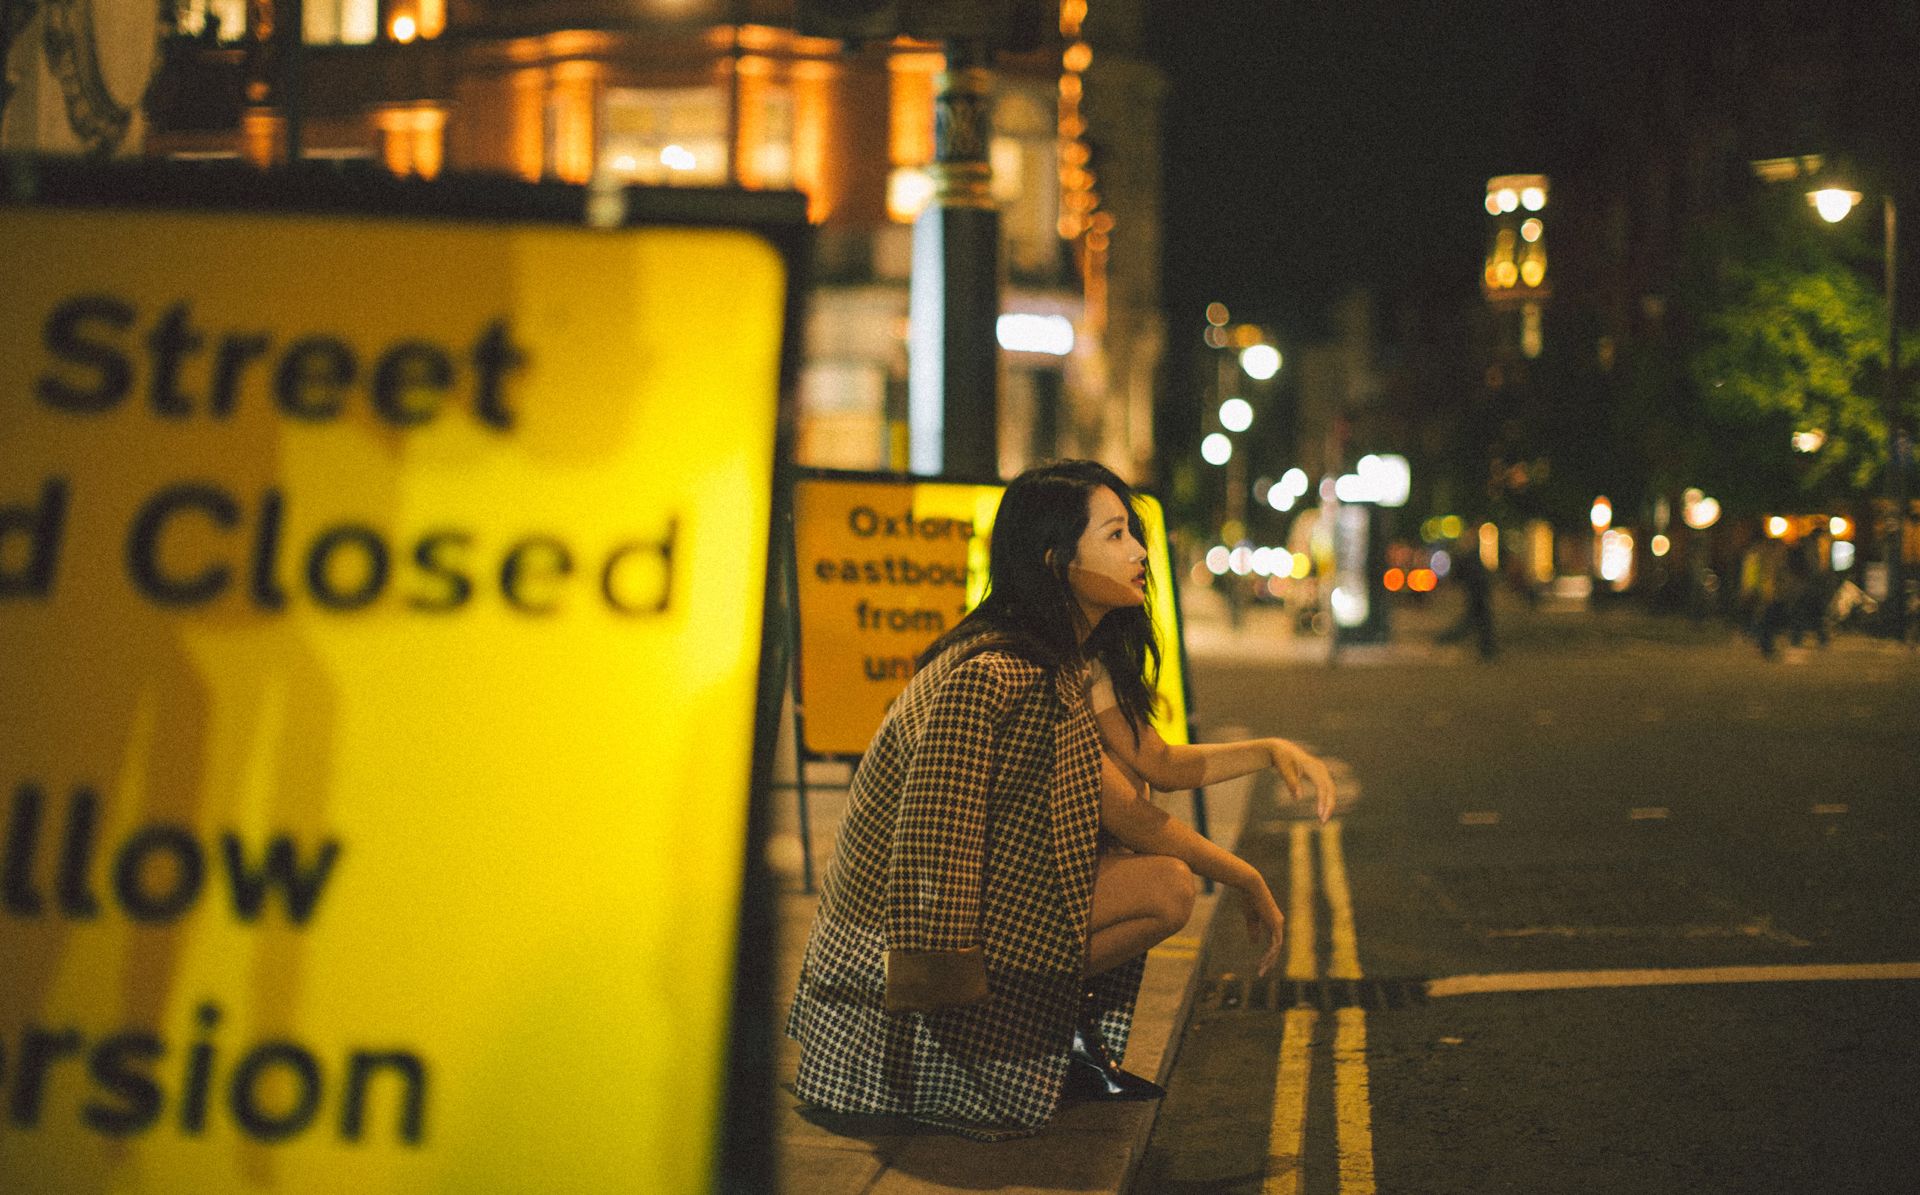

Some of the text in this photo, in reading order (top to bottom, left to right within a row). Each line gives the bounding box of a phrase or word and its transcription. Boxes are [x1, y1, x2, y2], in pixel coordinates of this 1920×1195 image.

[34, 293, 527, 438] Street
[124, 480, 680, 617] Closed
[815, 555, 974, 586] eastbou
[857, 597, 945, 632] from
[863, 655, 920, 682] un
[4, 778, 342, 929] llow
[0, 998, 434, 1147] rsion
